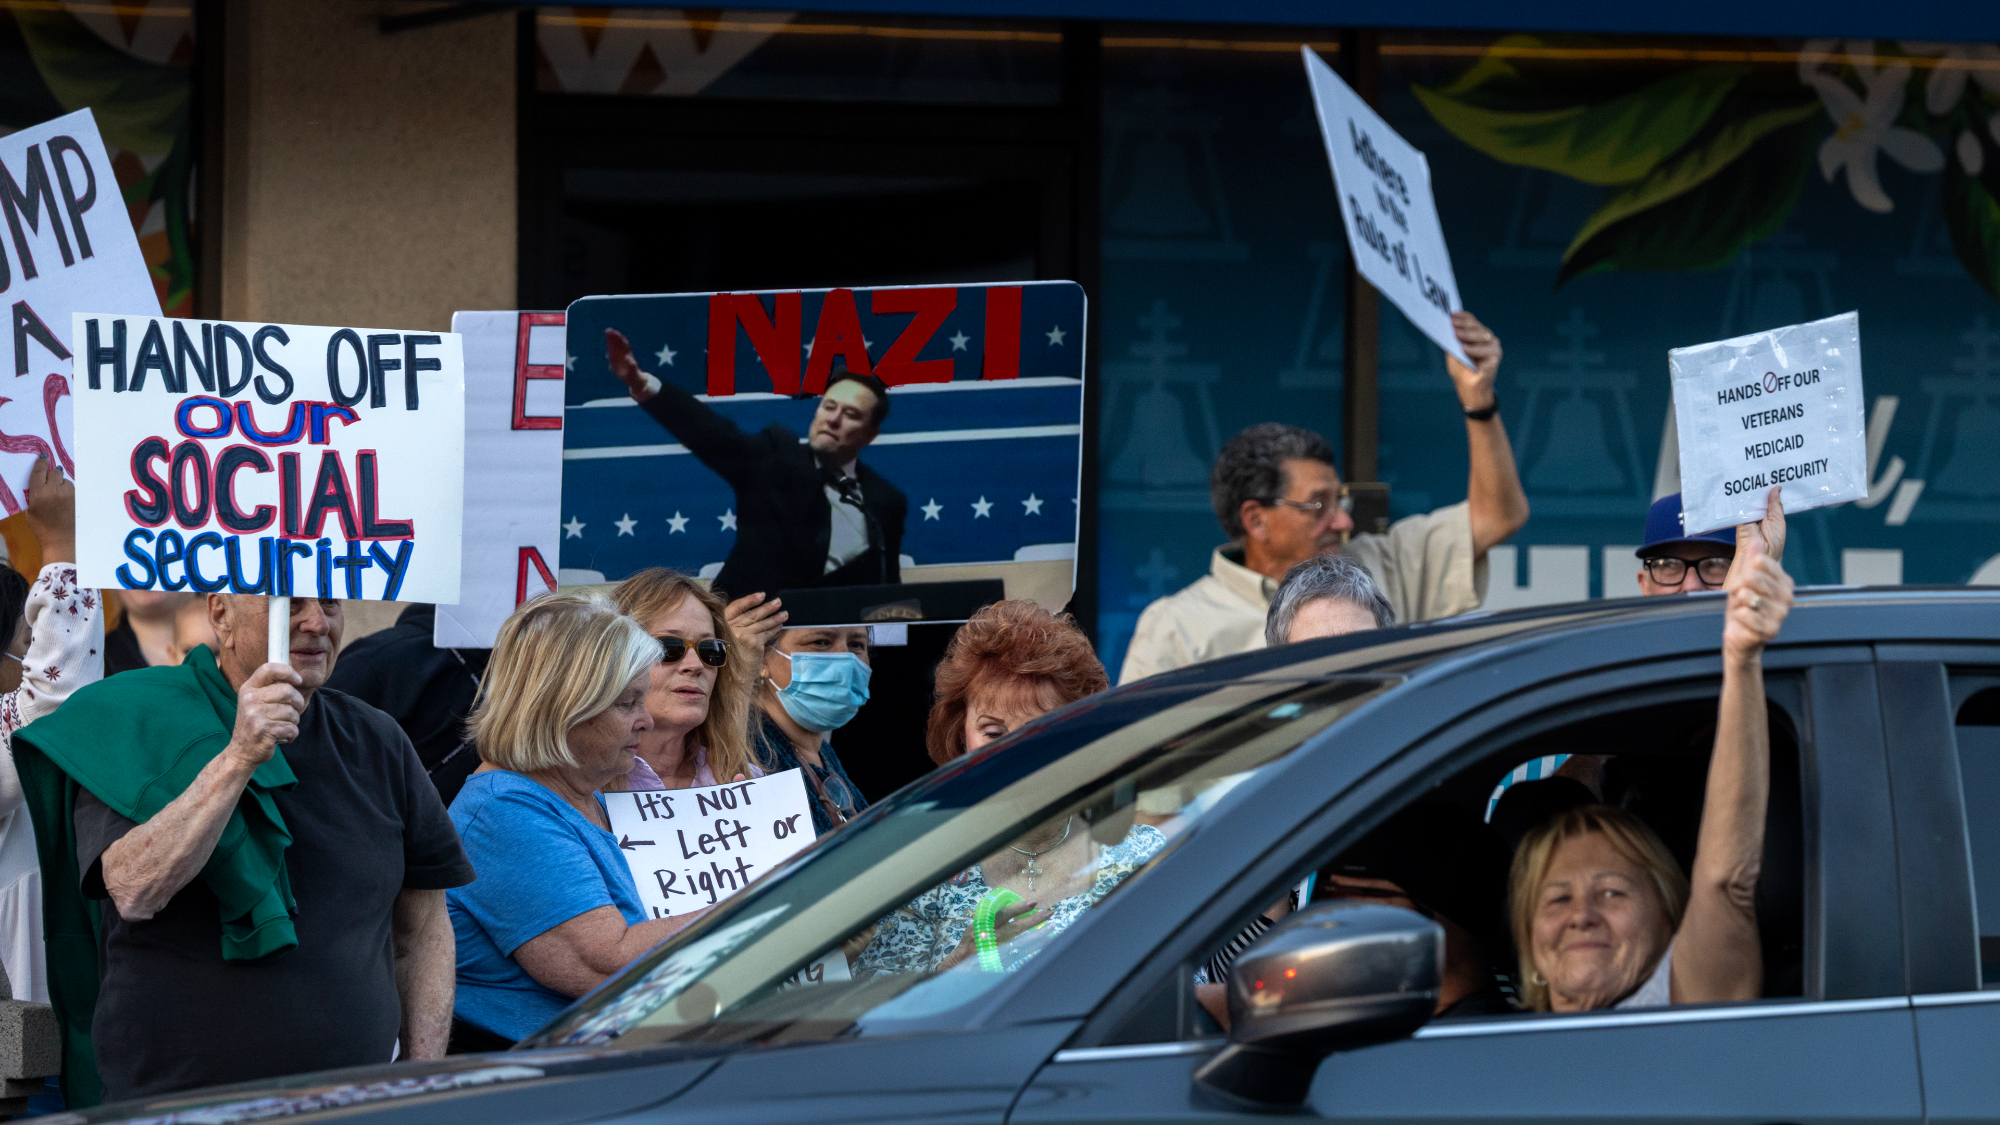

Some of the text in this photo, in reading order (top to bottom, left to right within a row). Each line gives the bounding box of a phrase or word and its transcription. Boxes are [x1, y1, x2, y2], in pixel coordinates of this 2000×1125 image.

[1348, 193, 1392, 263] Rule
[1391, 239, 1412, 283] of
[85, 318, 441, 411] HANDS OFF
[706, 286, 1023, 399] NAZI
[1717, 382, 1762, 405] HANDS
[1793, 369, 1820, 388] OUR
[1741, 403, 1804, 430] VETERANS
[1744, 434, 1804, 460] MEDICAID
[124, 436, 414, 541] SOCIAL
[1724, 457, 1828, 496] SOCIAL SECURITY
[695, 781, 756, 817] NOT
[676, 813, 802, 860] Left or
[653, 856, 754, 904] Right
